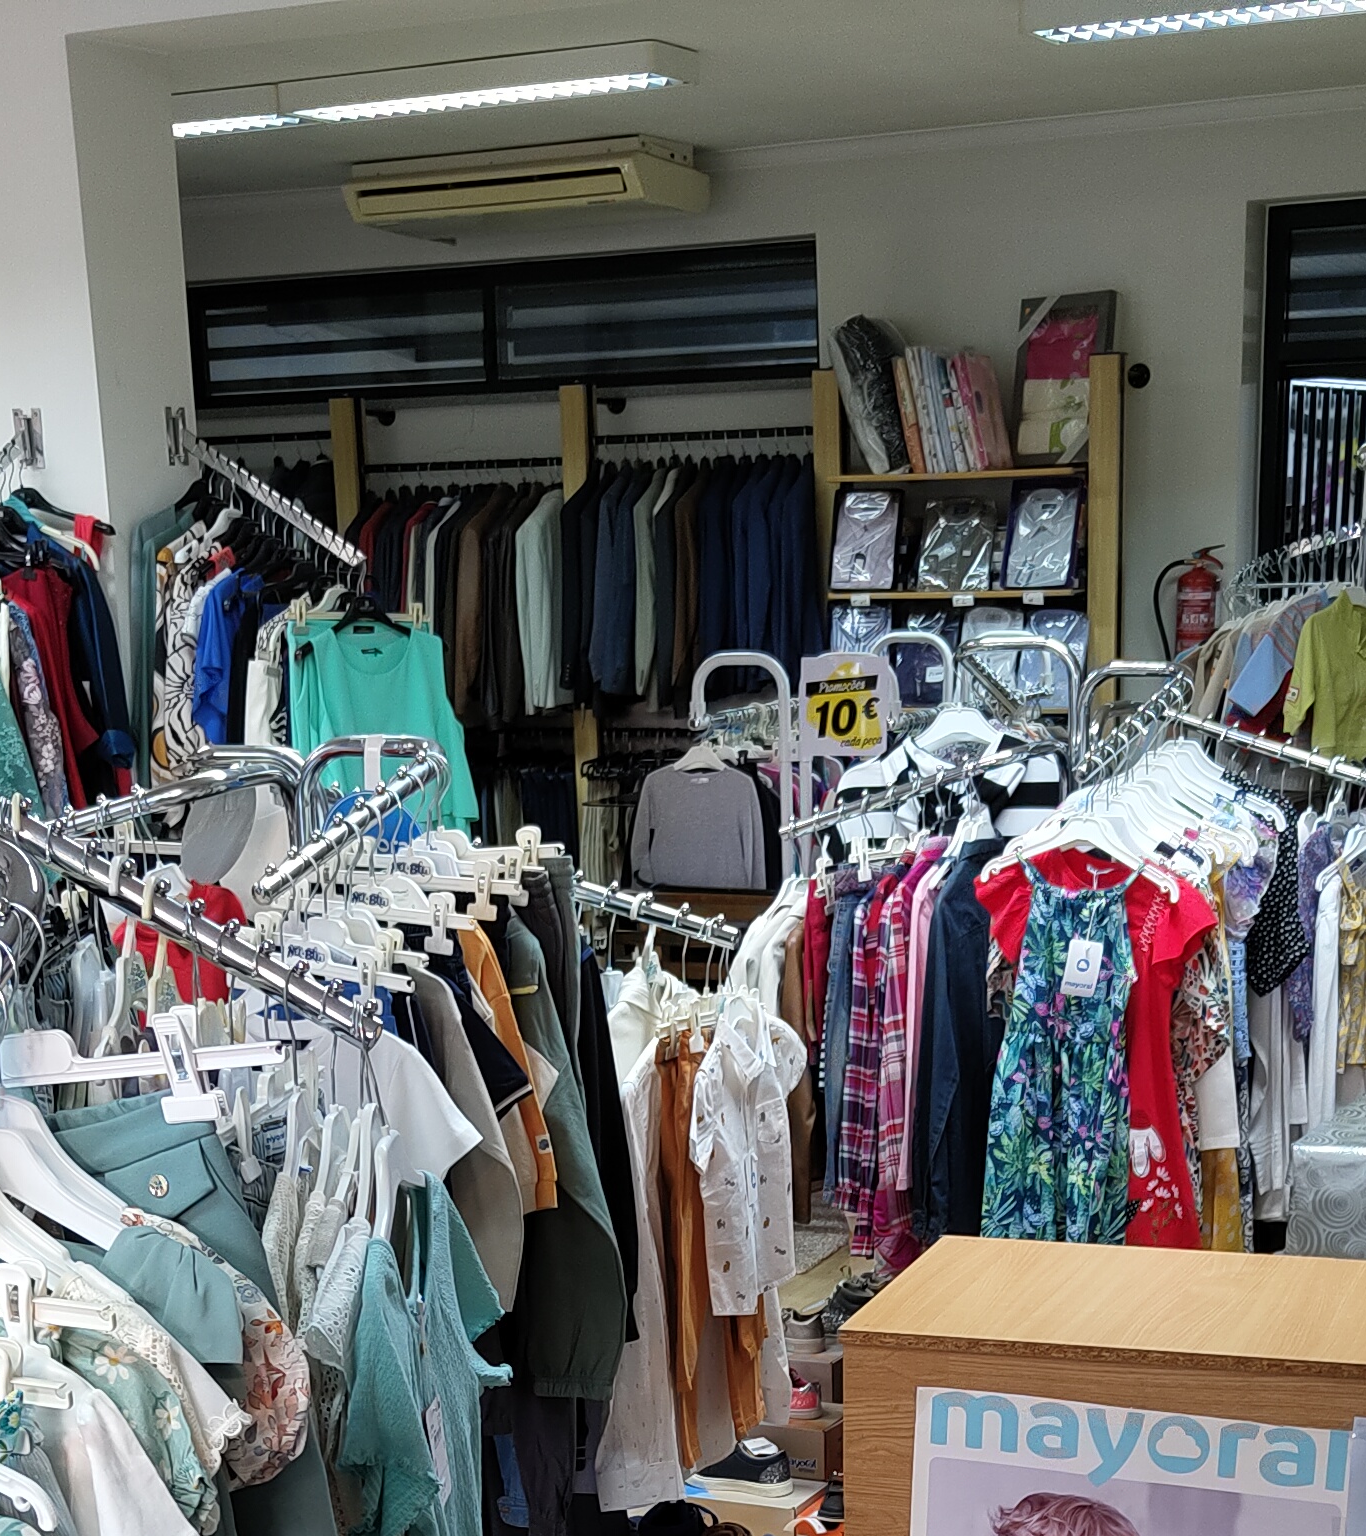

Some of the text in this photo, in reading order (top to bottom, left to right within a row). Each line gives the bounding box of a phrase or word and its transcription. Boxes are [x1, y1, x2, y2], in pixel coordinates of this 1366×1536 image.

[818, 679, 866, 694] Promoções
[816, 697, 881, 739] 10 €
[840, 736, 861, 747] cada
[1065, 981, 1094, 990] mayoral
[929, 1391, 1350, 1492] mayoral
